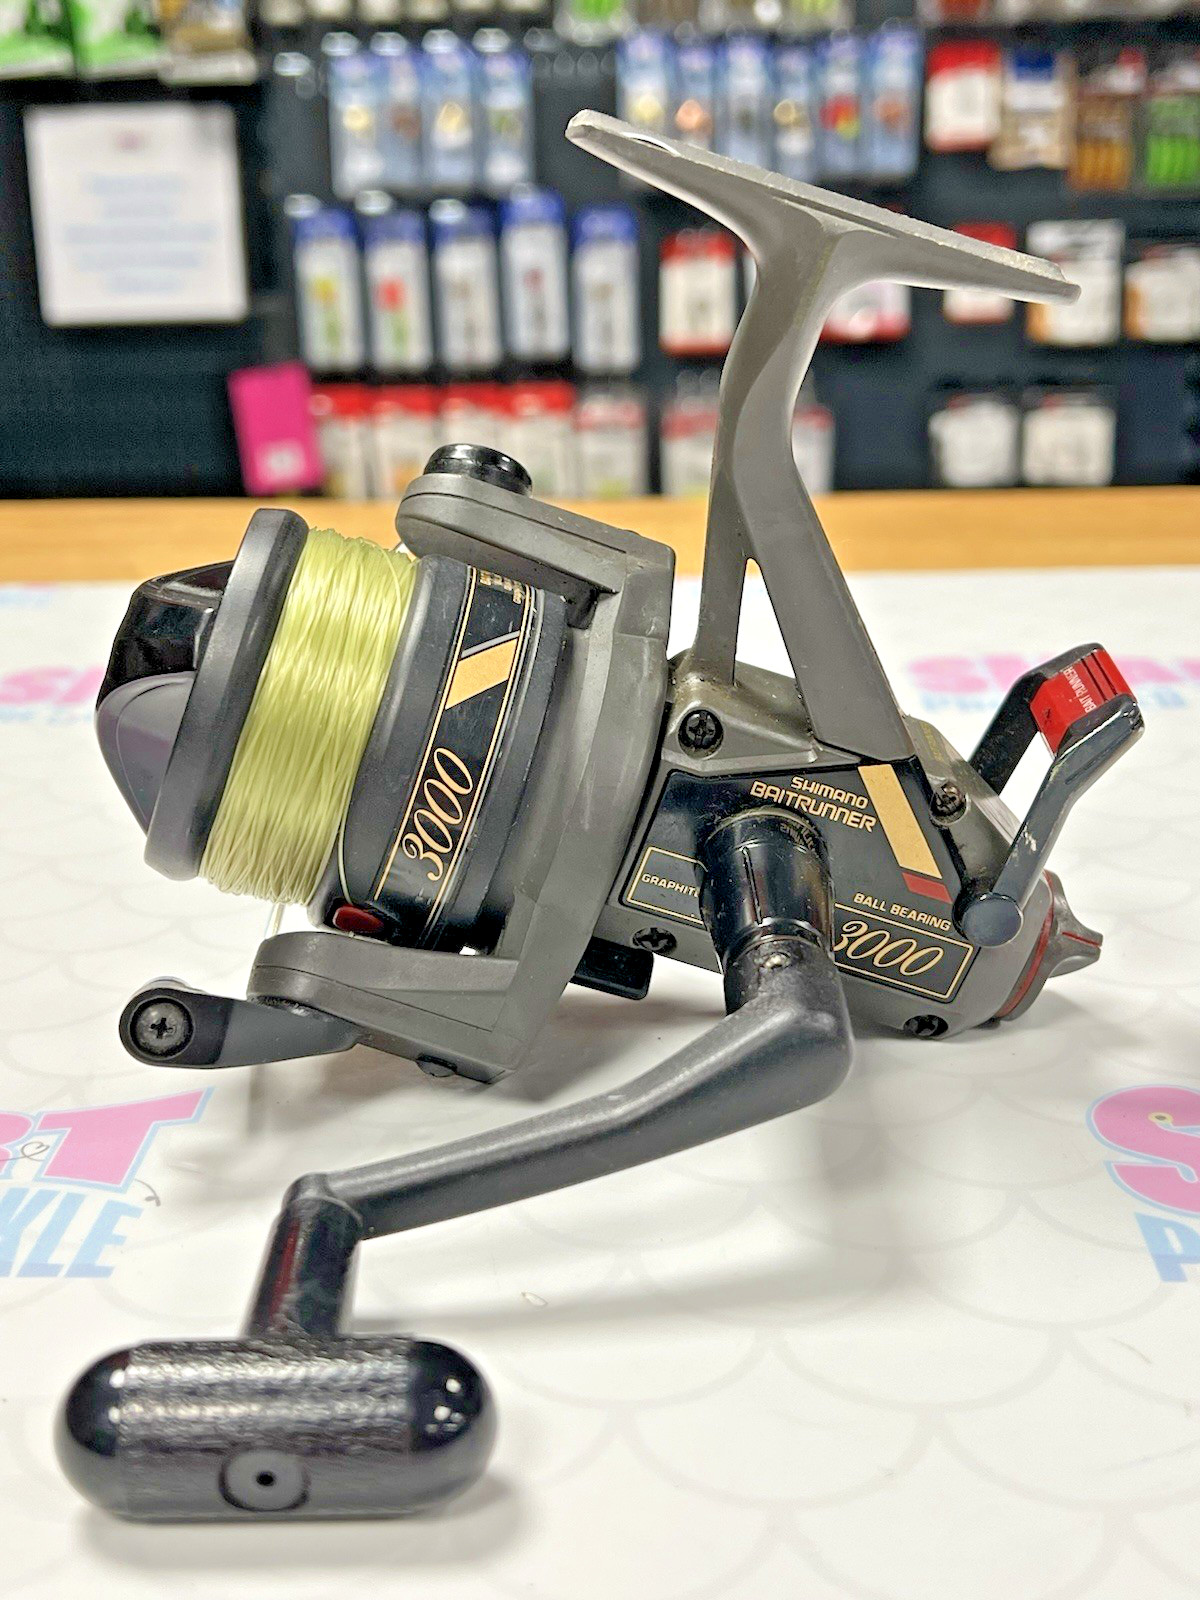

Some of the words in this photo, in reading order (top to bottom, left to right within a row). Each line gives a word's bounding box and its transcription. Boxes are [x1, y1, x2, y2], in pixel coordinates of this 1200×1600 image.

[1079, 694, 1097, 713] BAIT
[402, 747, 474, 881] 3000
[749, 780, 877, 833] BAITRUNNER
[790, 776, 869, 809] SHIMANO
[853, 892, 887, 912] BALL
[889, 903, 952, 932] BEARING
[833, 920, 944, 976] 3000
